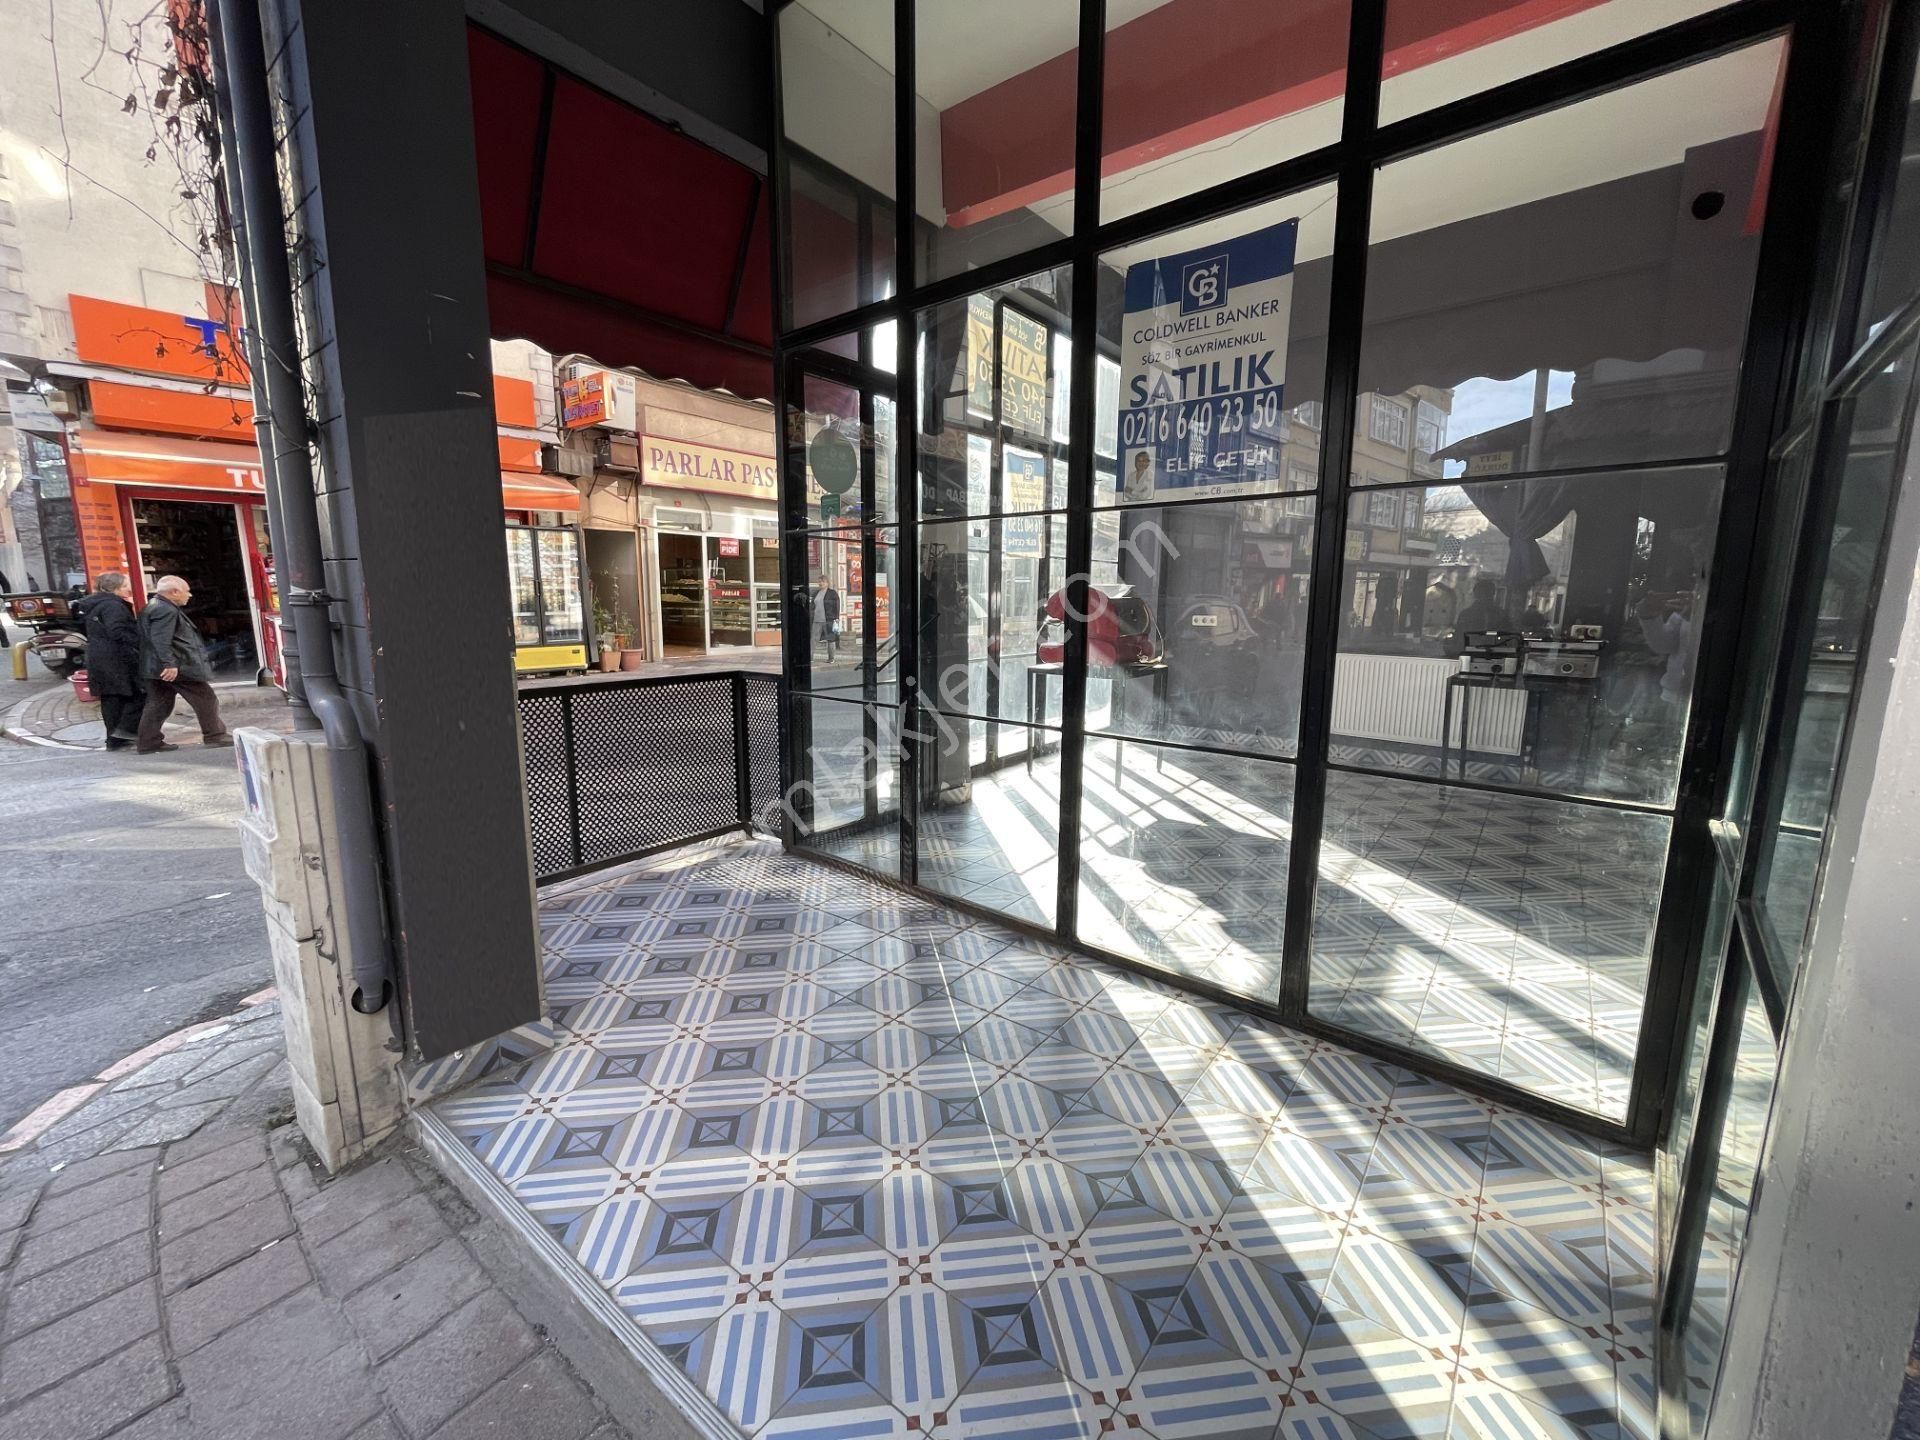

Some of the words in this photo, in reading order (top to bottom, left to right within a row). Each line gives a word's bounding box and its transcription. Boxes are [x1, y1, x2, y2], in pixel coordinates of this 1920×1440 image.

[1133, 317, 1211, 345] COLDWELL
[1216, 299, 1280, 327] BANKER
[1141, 350, 1161, 366] SÖZ
[1165, 346, 1182, 361] BİR
[1185, 331, 1267, 357] GAYRİMENKUL
[1130, 350, 1275, 408] SATILIK
[1123, 411, 1170, 446] 0216
[1176, 402, 1212, 440] 640
[1220, 396, 1245, 434] 23
[1253, 391, 1278, 430] 50
[649, 447, 736, 482] PARLAR
[1166, 453, 1205, 473] ELİF
